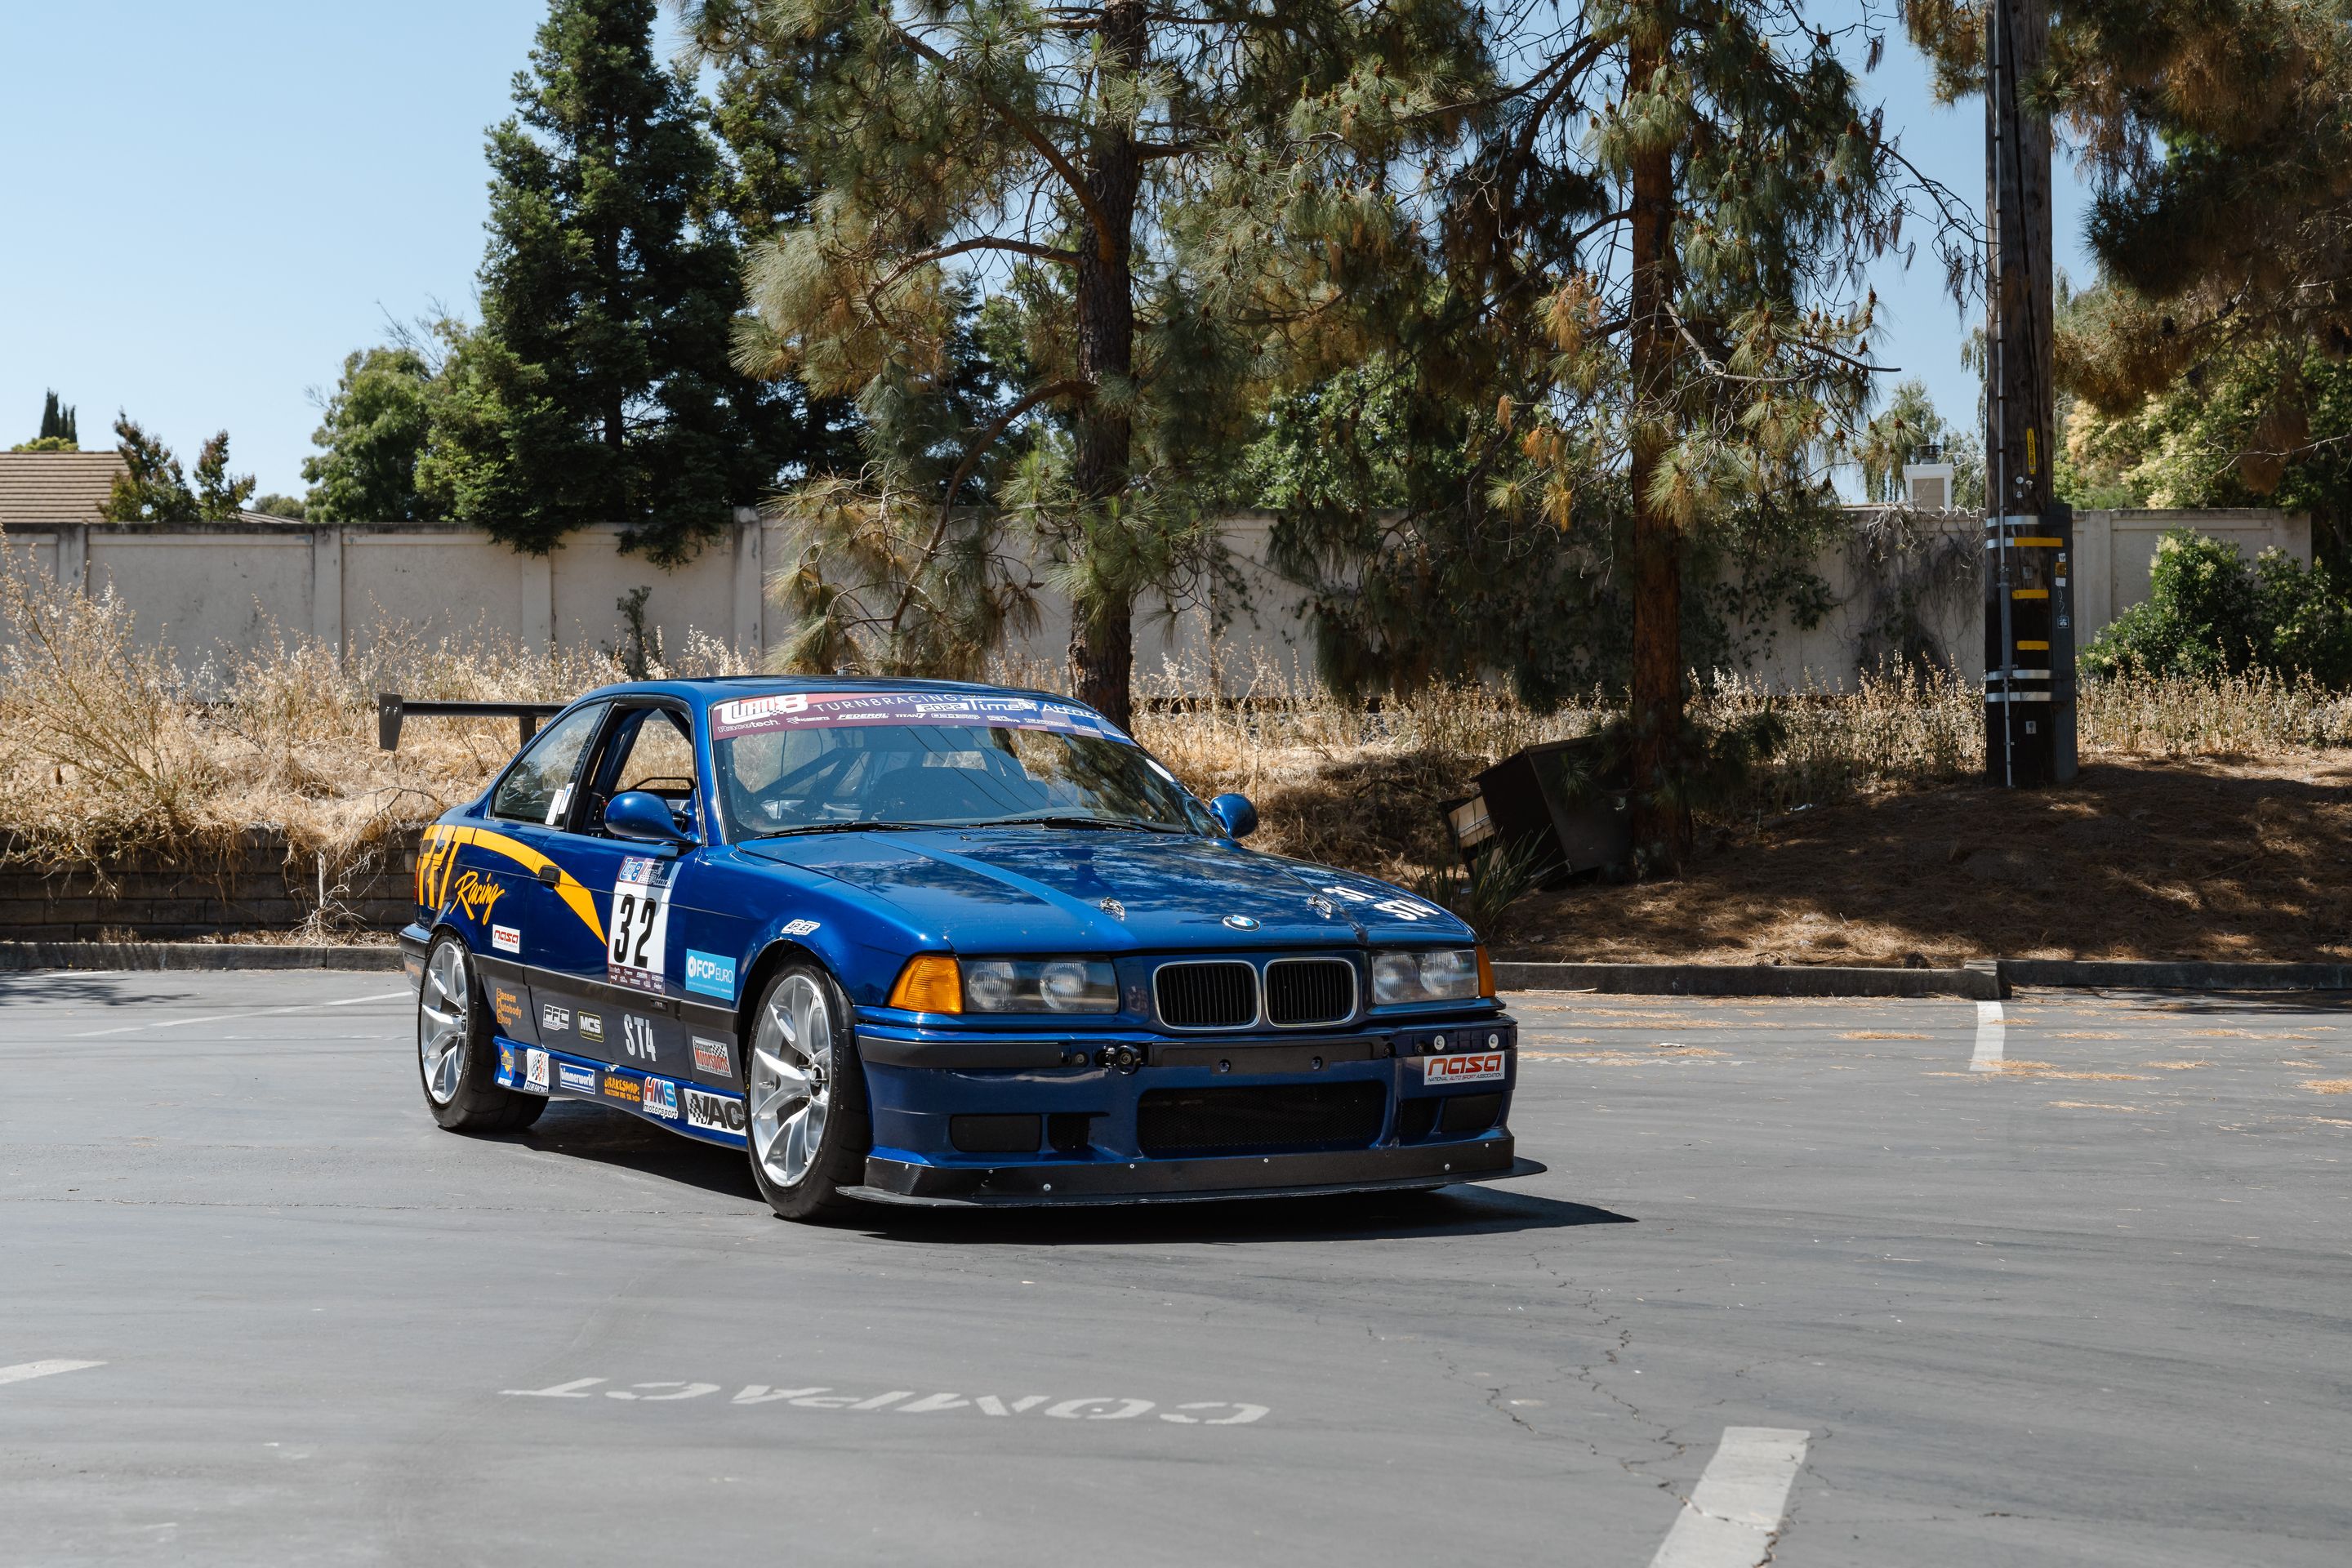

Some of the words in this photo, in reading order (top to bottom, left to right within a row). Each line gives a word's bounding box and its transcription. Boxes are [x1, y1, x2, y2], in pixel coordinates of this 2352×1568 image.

[920, 703, 964, 711] 2022
[961, 697, 1021, 711] Time
[449, 870, 505, 925] Racing
[1374, 899, 1440, 920] ST4
[494, 929, 519, 944] nasa
[613, 894, 657, 969] 32
[697, 959, 715, 979] FCP
[715, 967, 733, 984] EURO
[497, 1013, 512, 1027] Shop
[545, 1005, 569, 1025] PFC
[580, 1016, 601, 1034] MCS
[624, 1013, 657, 1062] ST4
[1428, 1055, 1502, 1076] nasa
[561, 1067, 594, 1087] bimmerworld
[644, 1077, 677, 1108] HMS
[644, 1103, 679, 1119] motorsport
[497, 1377, 1270, 1424] COMPACT
